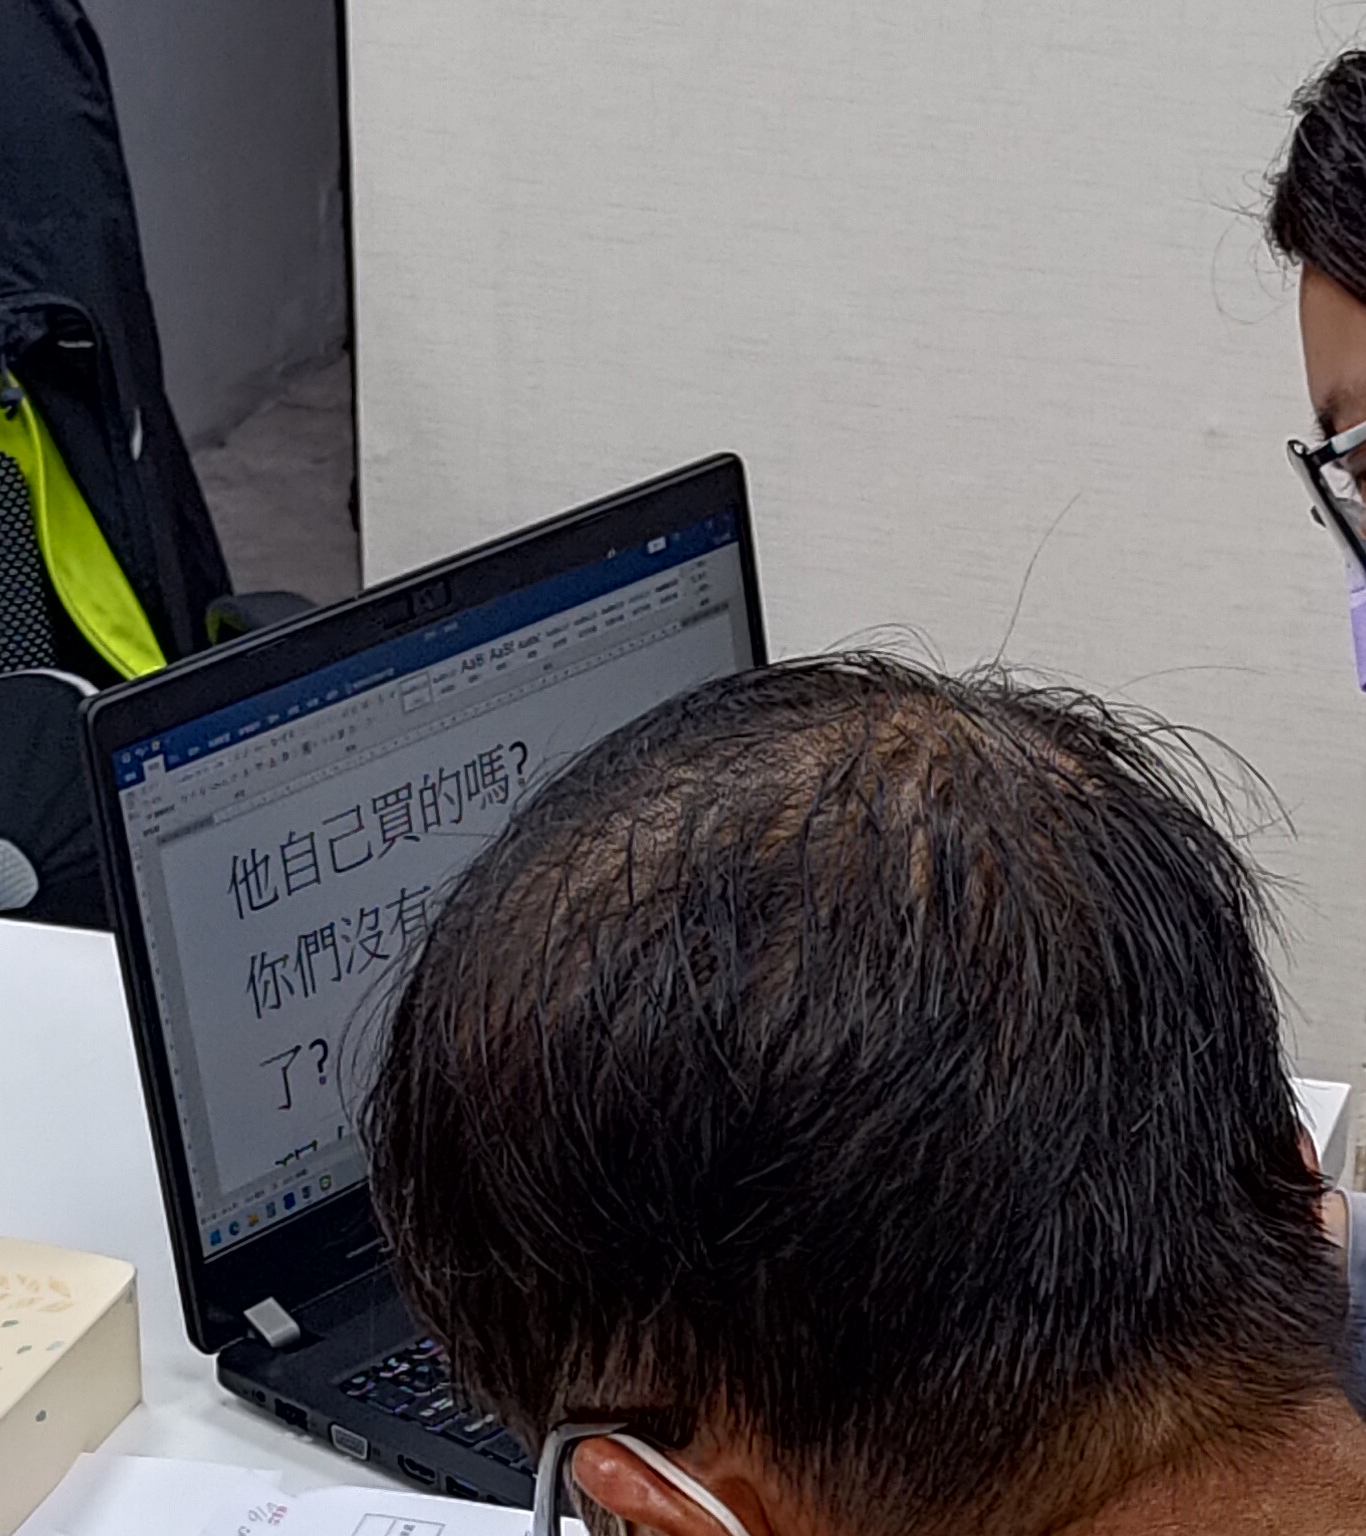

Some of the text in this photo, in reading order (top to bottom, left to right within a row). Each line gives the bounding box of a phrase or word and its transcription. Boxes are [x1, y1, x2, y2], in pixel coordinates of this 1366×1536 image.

[227, 741, 529, 920] 他自己買的嗎?
[246, 885, 433, 1019] 你們沒有
[260, 1038, 329, 1110] 了?
